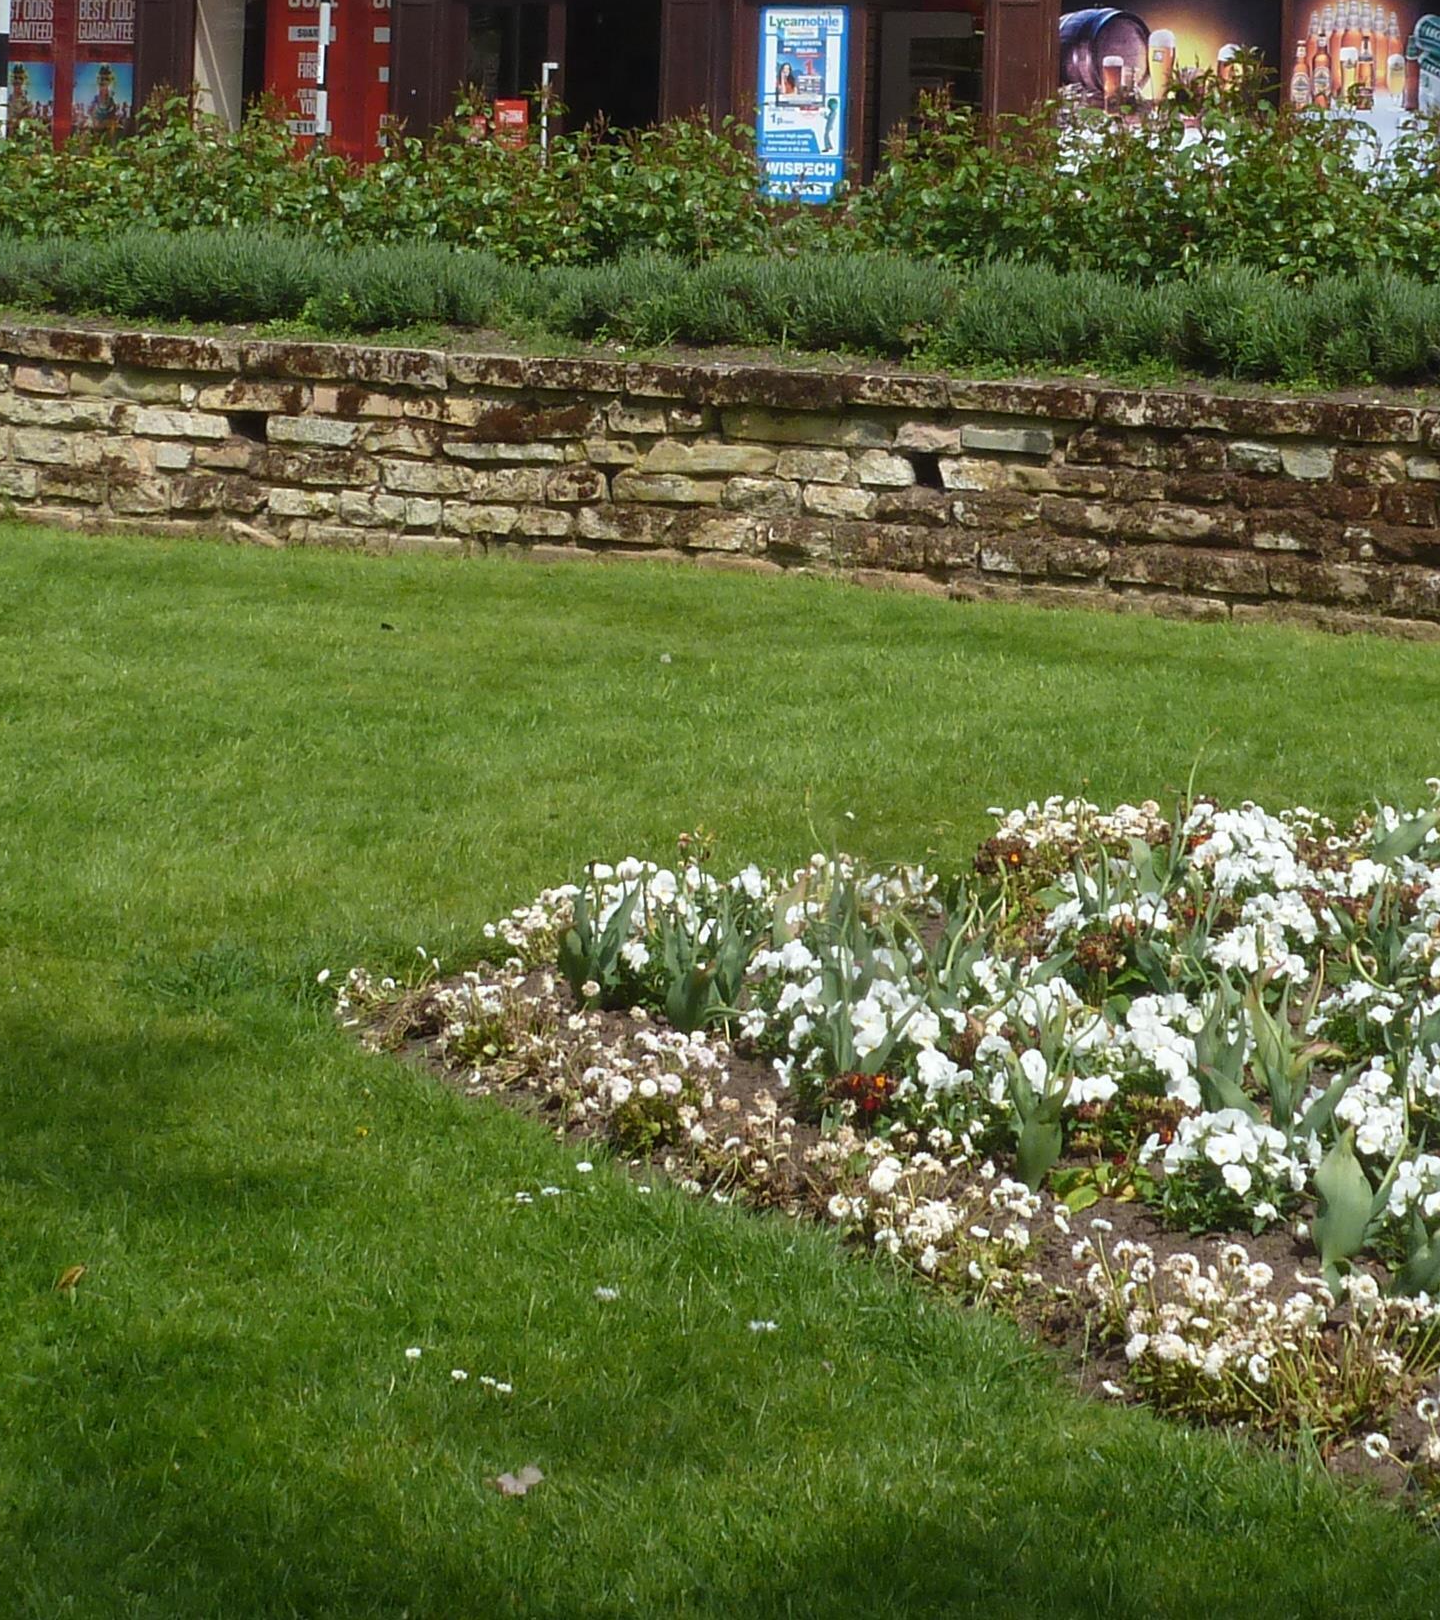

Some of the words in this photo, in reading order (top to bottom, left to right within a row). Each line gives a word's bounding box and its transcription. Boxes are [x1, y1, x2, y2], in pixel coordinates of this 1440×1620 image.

[24, 0, 54, 20] ODDS
[79, 0, 107, 20] BEST
[769, 16, 839, 28] Lycamobile
[766, 161, 836, 176] WISBECH
